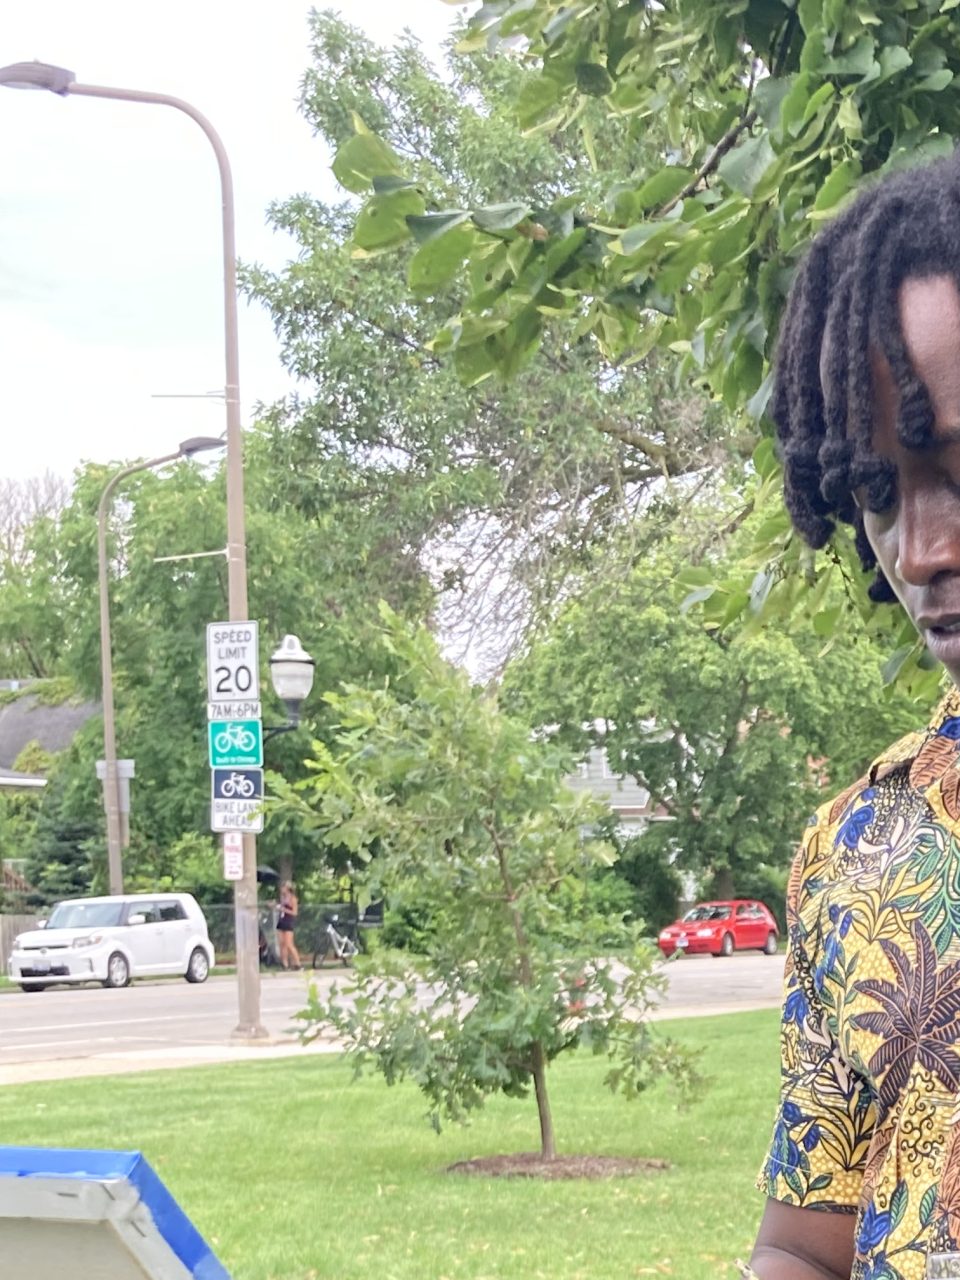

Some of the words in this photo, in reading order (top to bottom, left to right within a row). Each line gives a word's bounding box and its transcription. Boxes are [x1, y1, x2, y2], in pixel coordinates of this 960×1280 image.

[213, 630, 252, 645] SPEED
[218, 646, 248, 660] LIMIT
[215, 665, 252, 693] 20
[215, 802, 235, 813] BIKE
